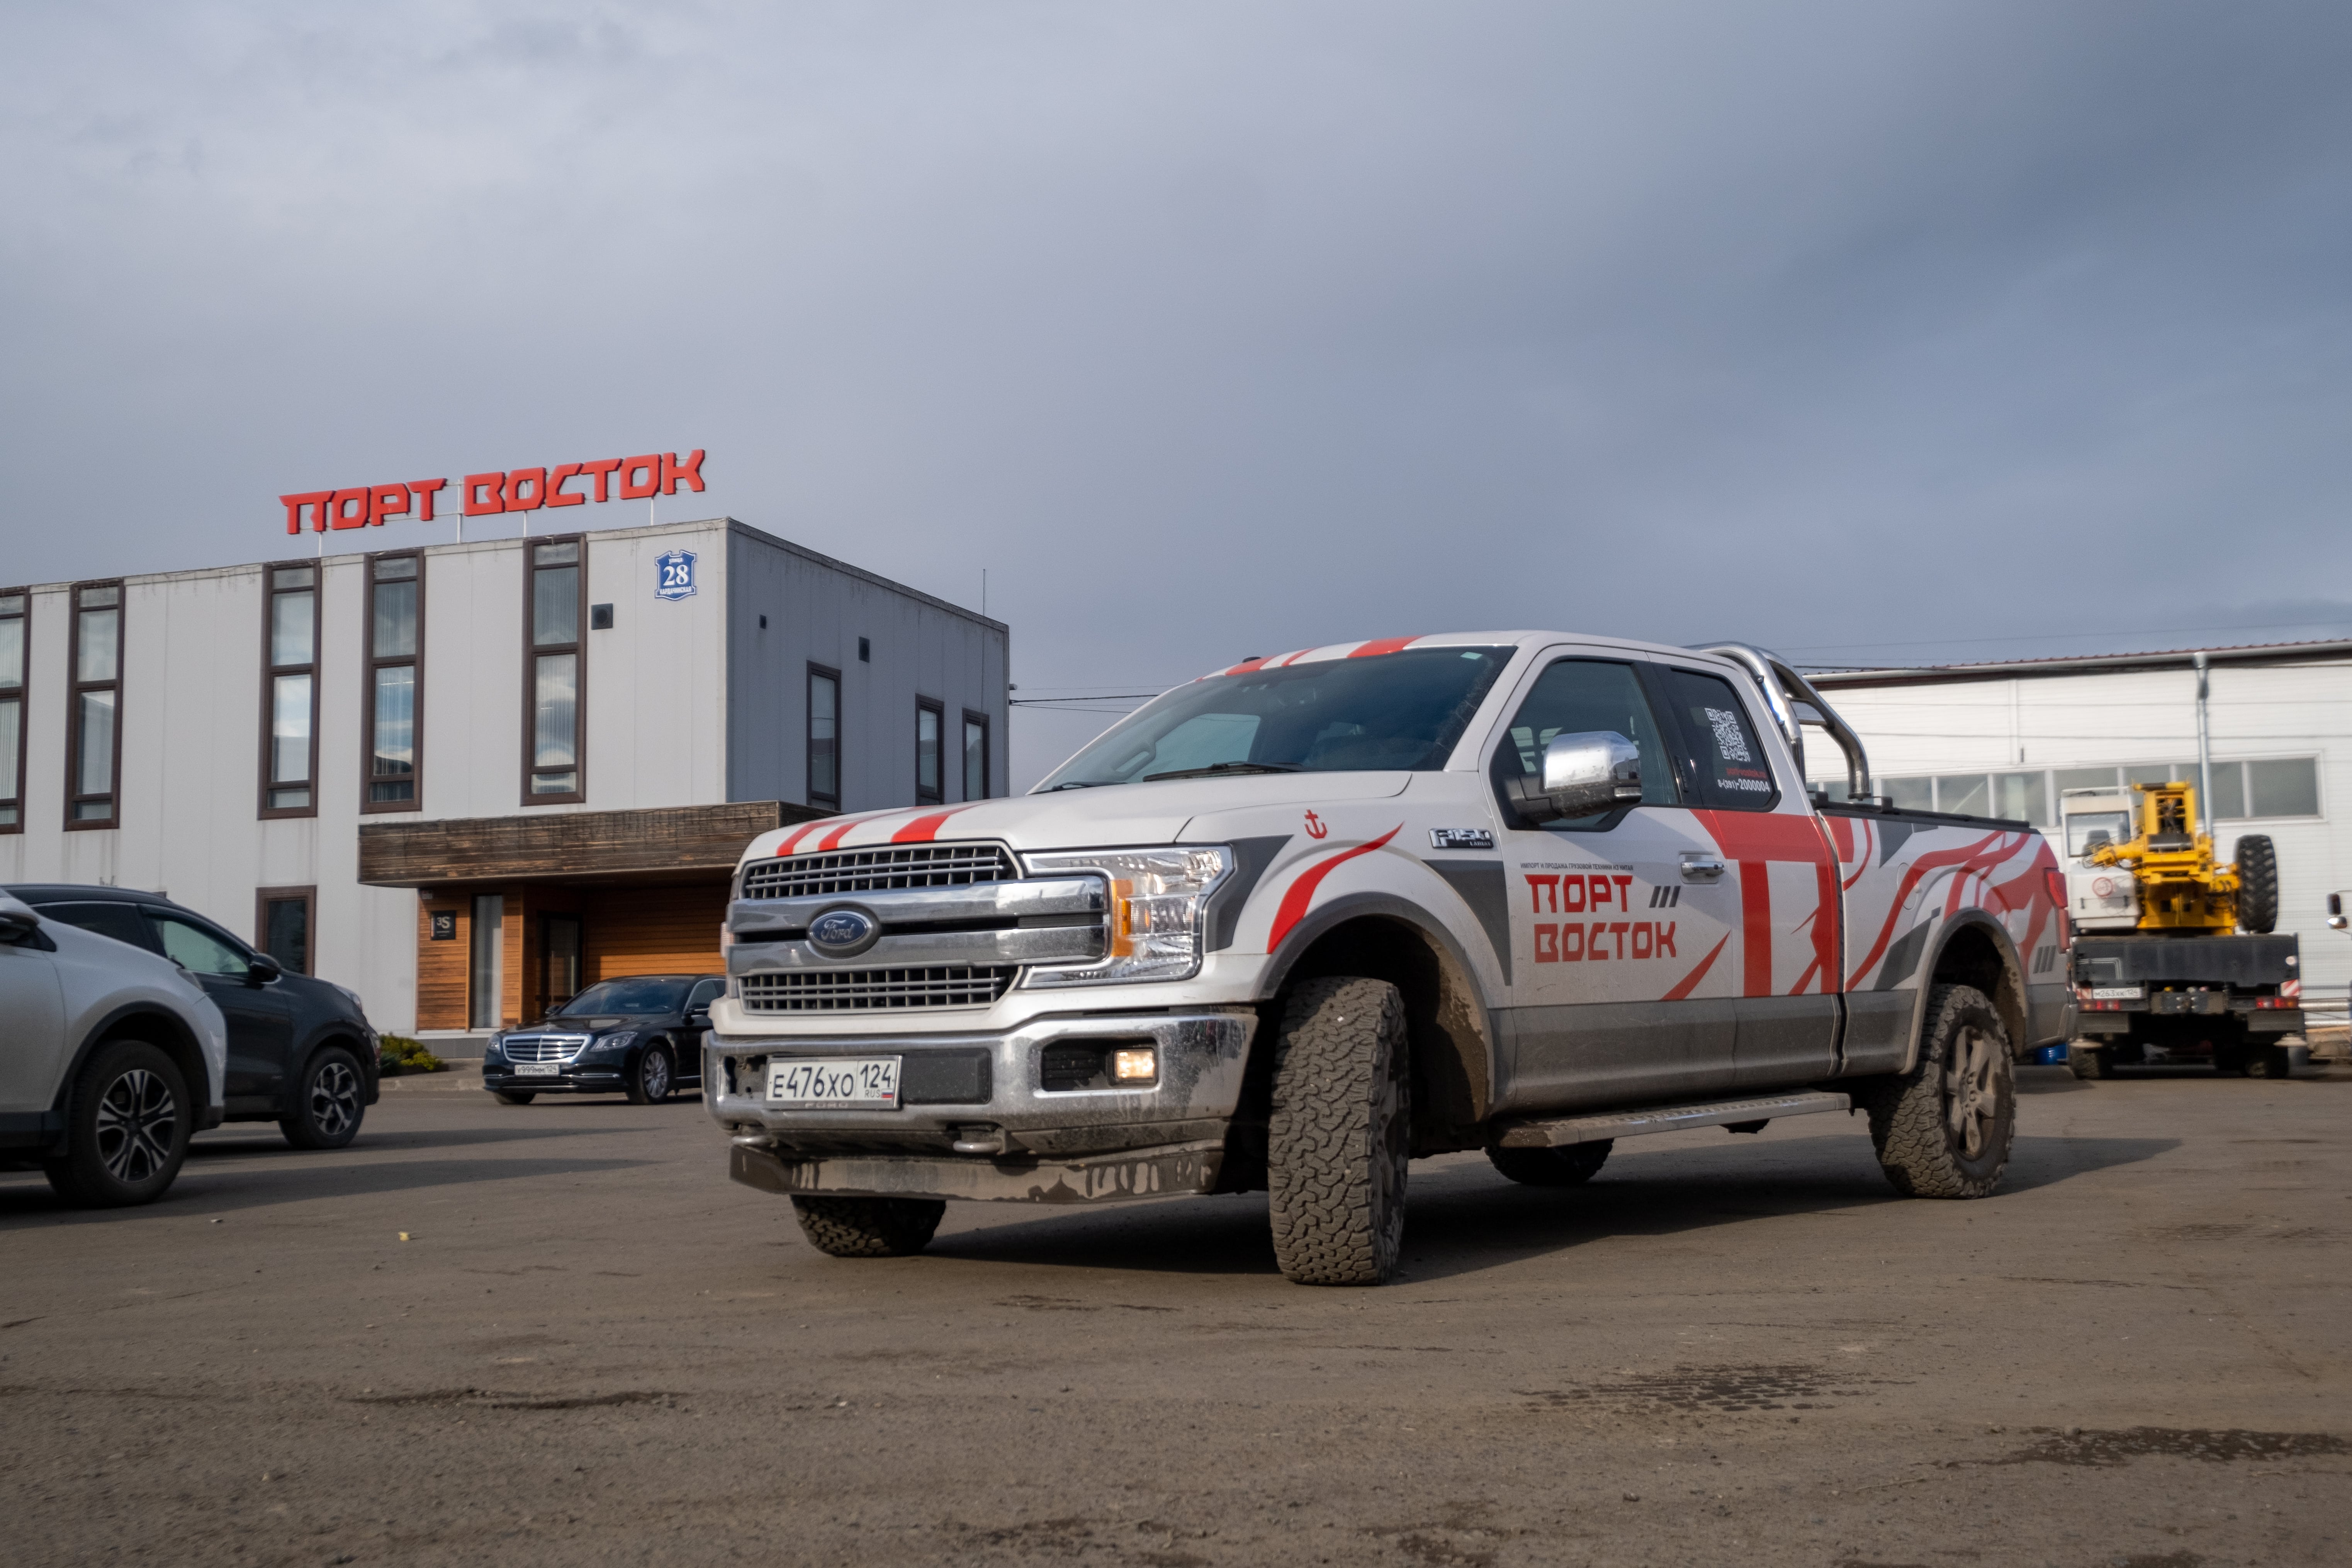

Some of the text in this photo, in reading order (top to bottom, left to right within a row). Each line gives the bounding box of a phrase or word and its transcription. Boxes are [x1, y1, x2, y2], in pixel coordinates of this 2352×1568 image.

[279, 449, 705, 534] ПОРТ ВОСТОК
[663, 564, 689, 586] 28
[1717, 778, 1770, 792] 8-(391)-2000004
[1524, 874, 1633, 913] ПОРТ
[821, 919, 855, 940] Ford
[1534, 921, 1676, 963] ВОСТОК
[773, 1063, 891, 1097] Е476ХО 124
[865, 1089, 880, 1098] RUS
